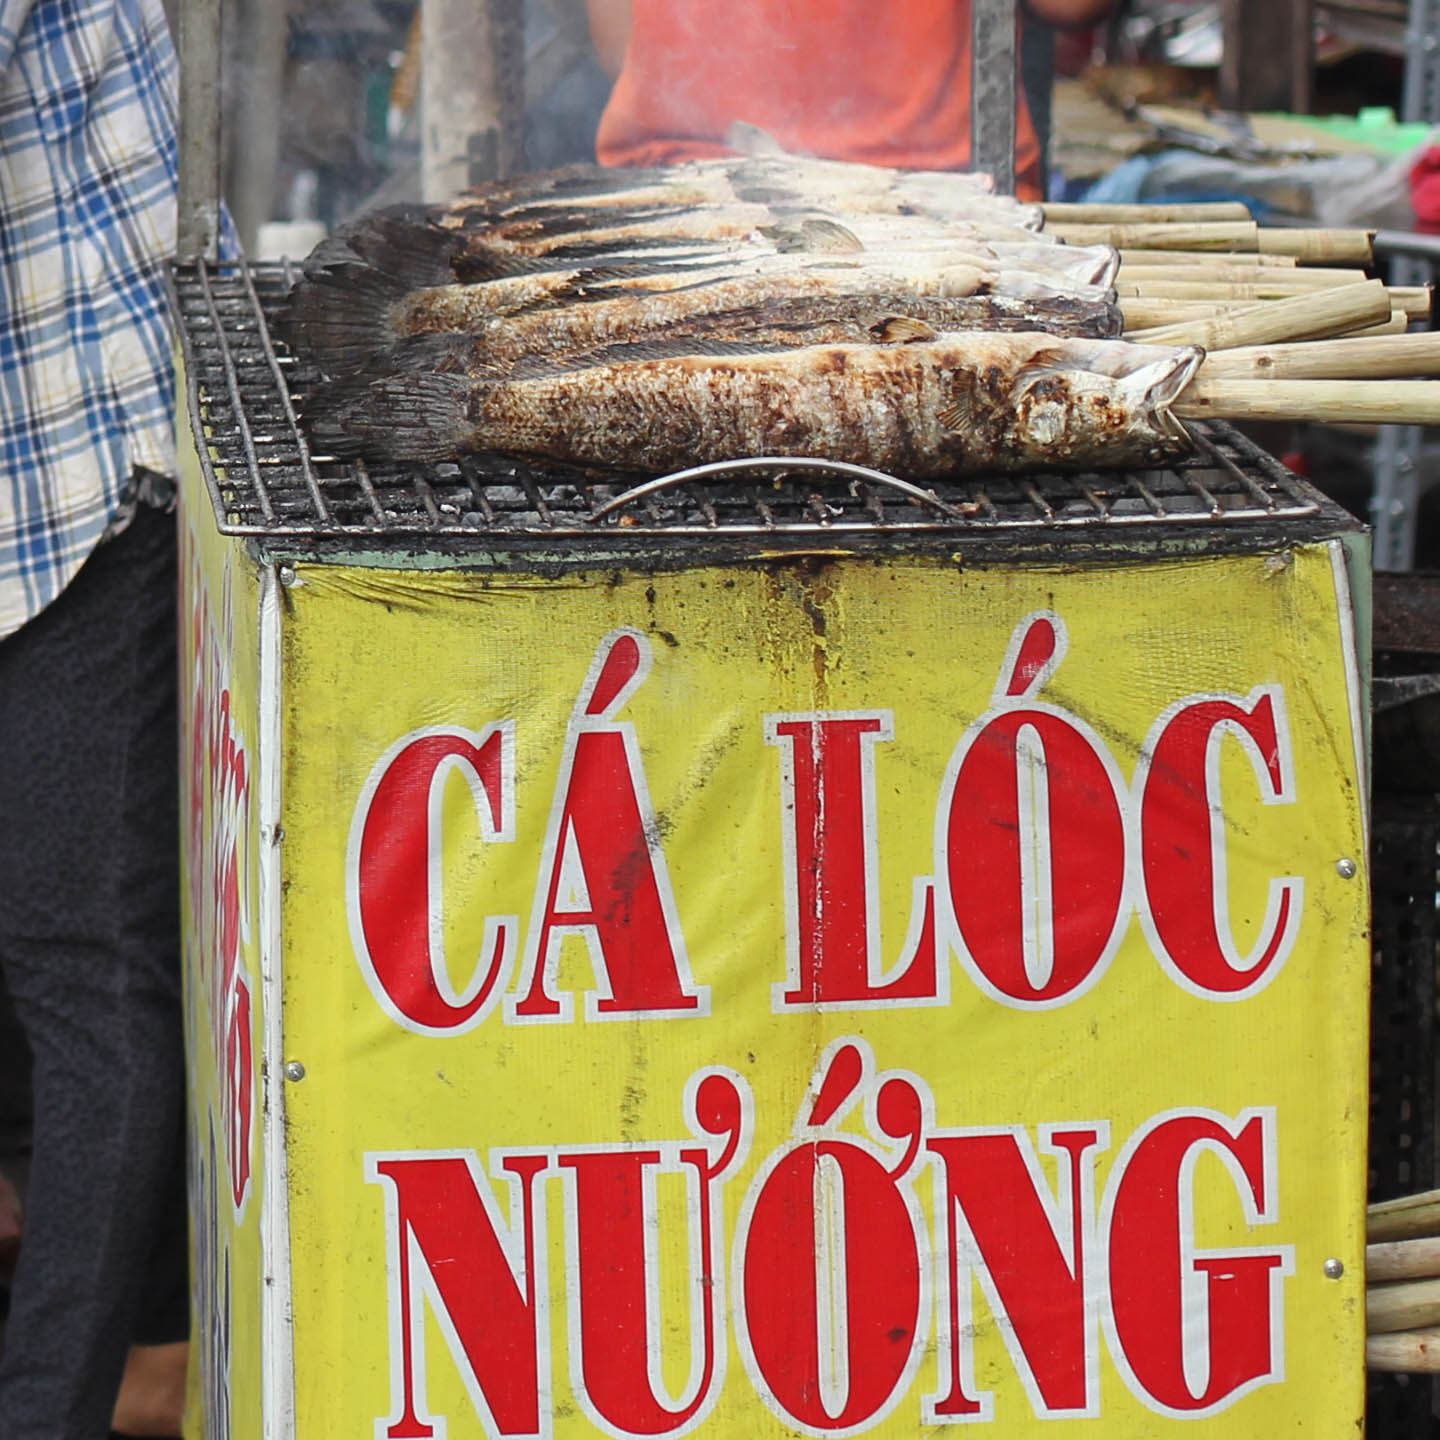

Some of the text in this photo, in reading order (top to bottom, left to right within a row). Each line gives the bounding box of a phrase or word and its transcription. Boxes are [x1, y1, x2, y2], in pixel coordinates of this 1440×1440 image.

[356, 633, 701, 1028] CÁ
[775, 615, 1297, 1005] LÓC
[377, 1042, 1285, 1438] NƯỚNG
